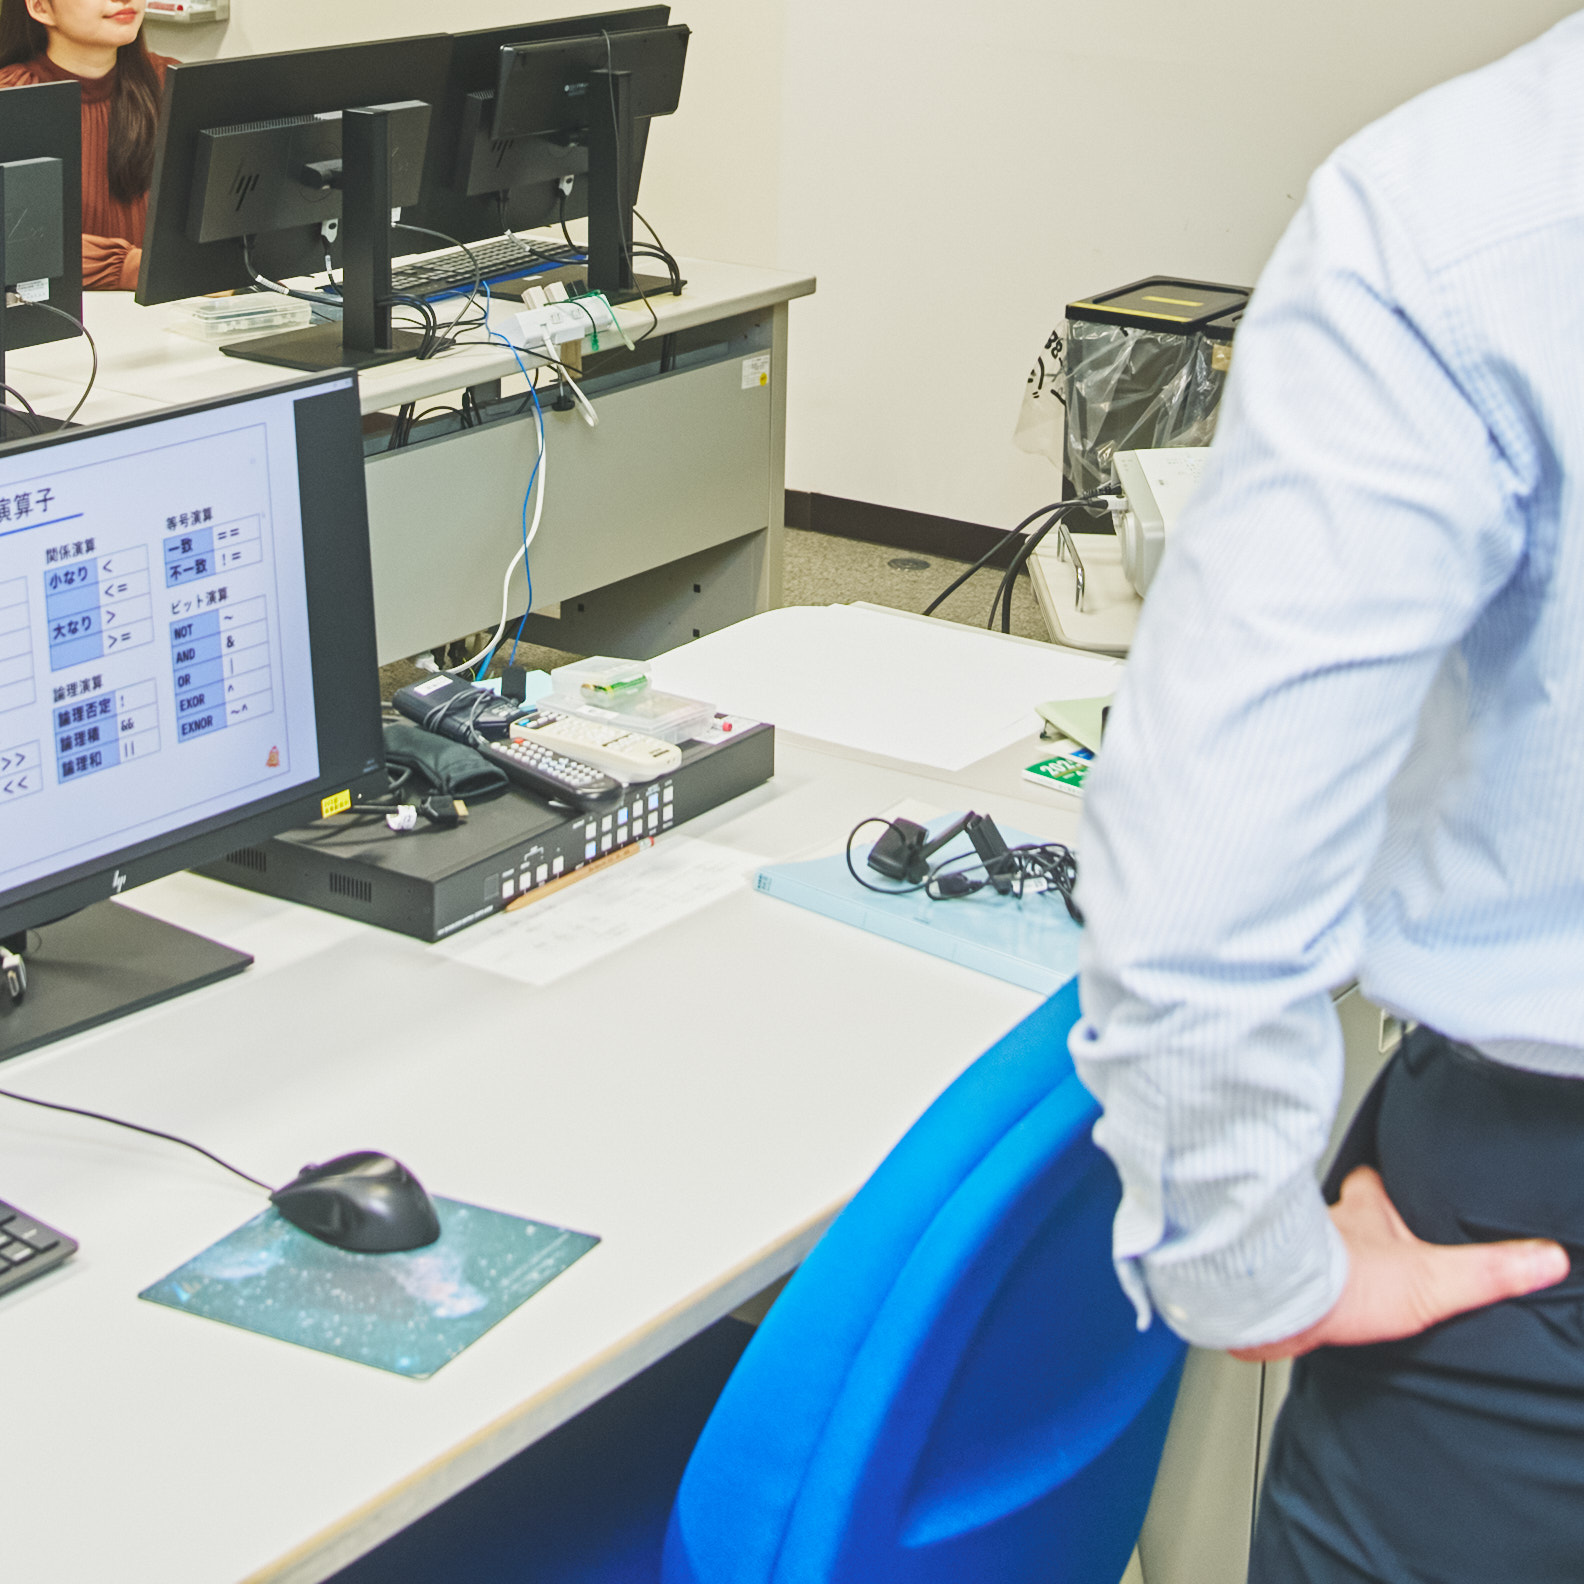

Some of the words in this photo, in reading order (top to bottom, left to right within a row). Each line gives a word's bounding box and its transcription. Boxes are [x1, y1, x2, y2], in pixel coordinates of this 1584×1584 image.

[166, 506, 213, 531] 等号演算
[49, 566, 88, 590] 小なり
[171, 586, 228, 615] ビット演算
[53, 615, 92, 640] 大なり
[174, 623, 193, 640] NOT
[176, 648, 196, 664] AND
[226, 635, 235, 648] &
[53, 674, 103, 703] 論理演算
[177, 673, 191, 688] OR
[179, 693, 205, 712] EXOR
[181, 715, 213, 736] EXNOR
